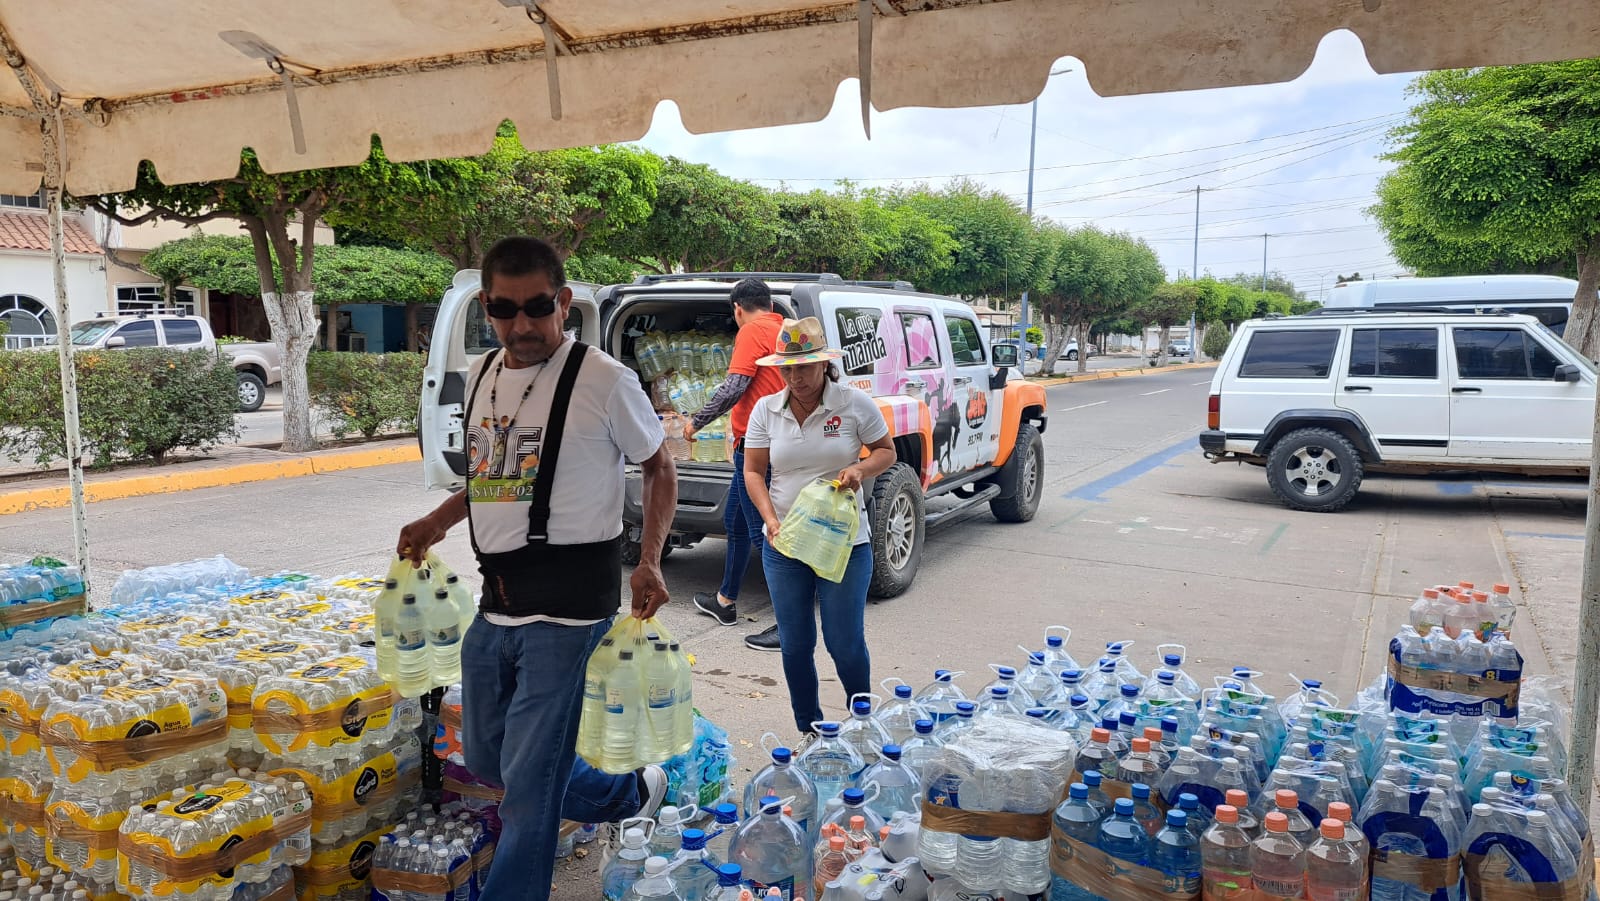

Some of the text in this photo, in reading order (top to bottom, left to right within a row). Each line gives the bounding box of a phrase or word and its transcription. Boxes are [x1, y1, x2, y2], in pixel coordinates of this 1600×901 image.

[839, 313, 875, 340] La que
[467, 426, 542, 480] DIF
